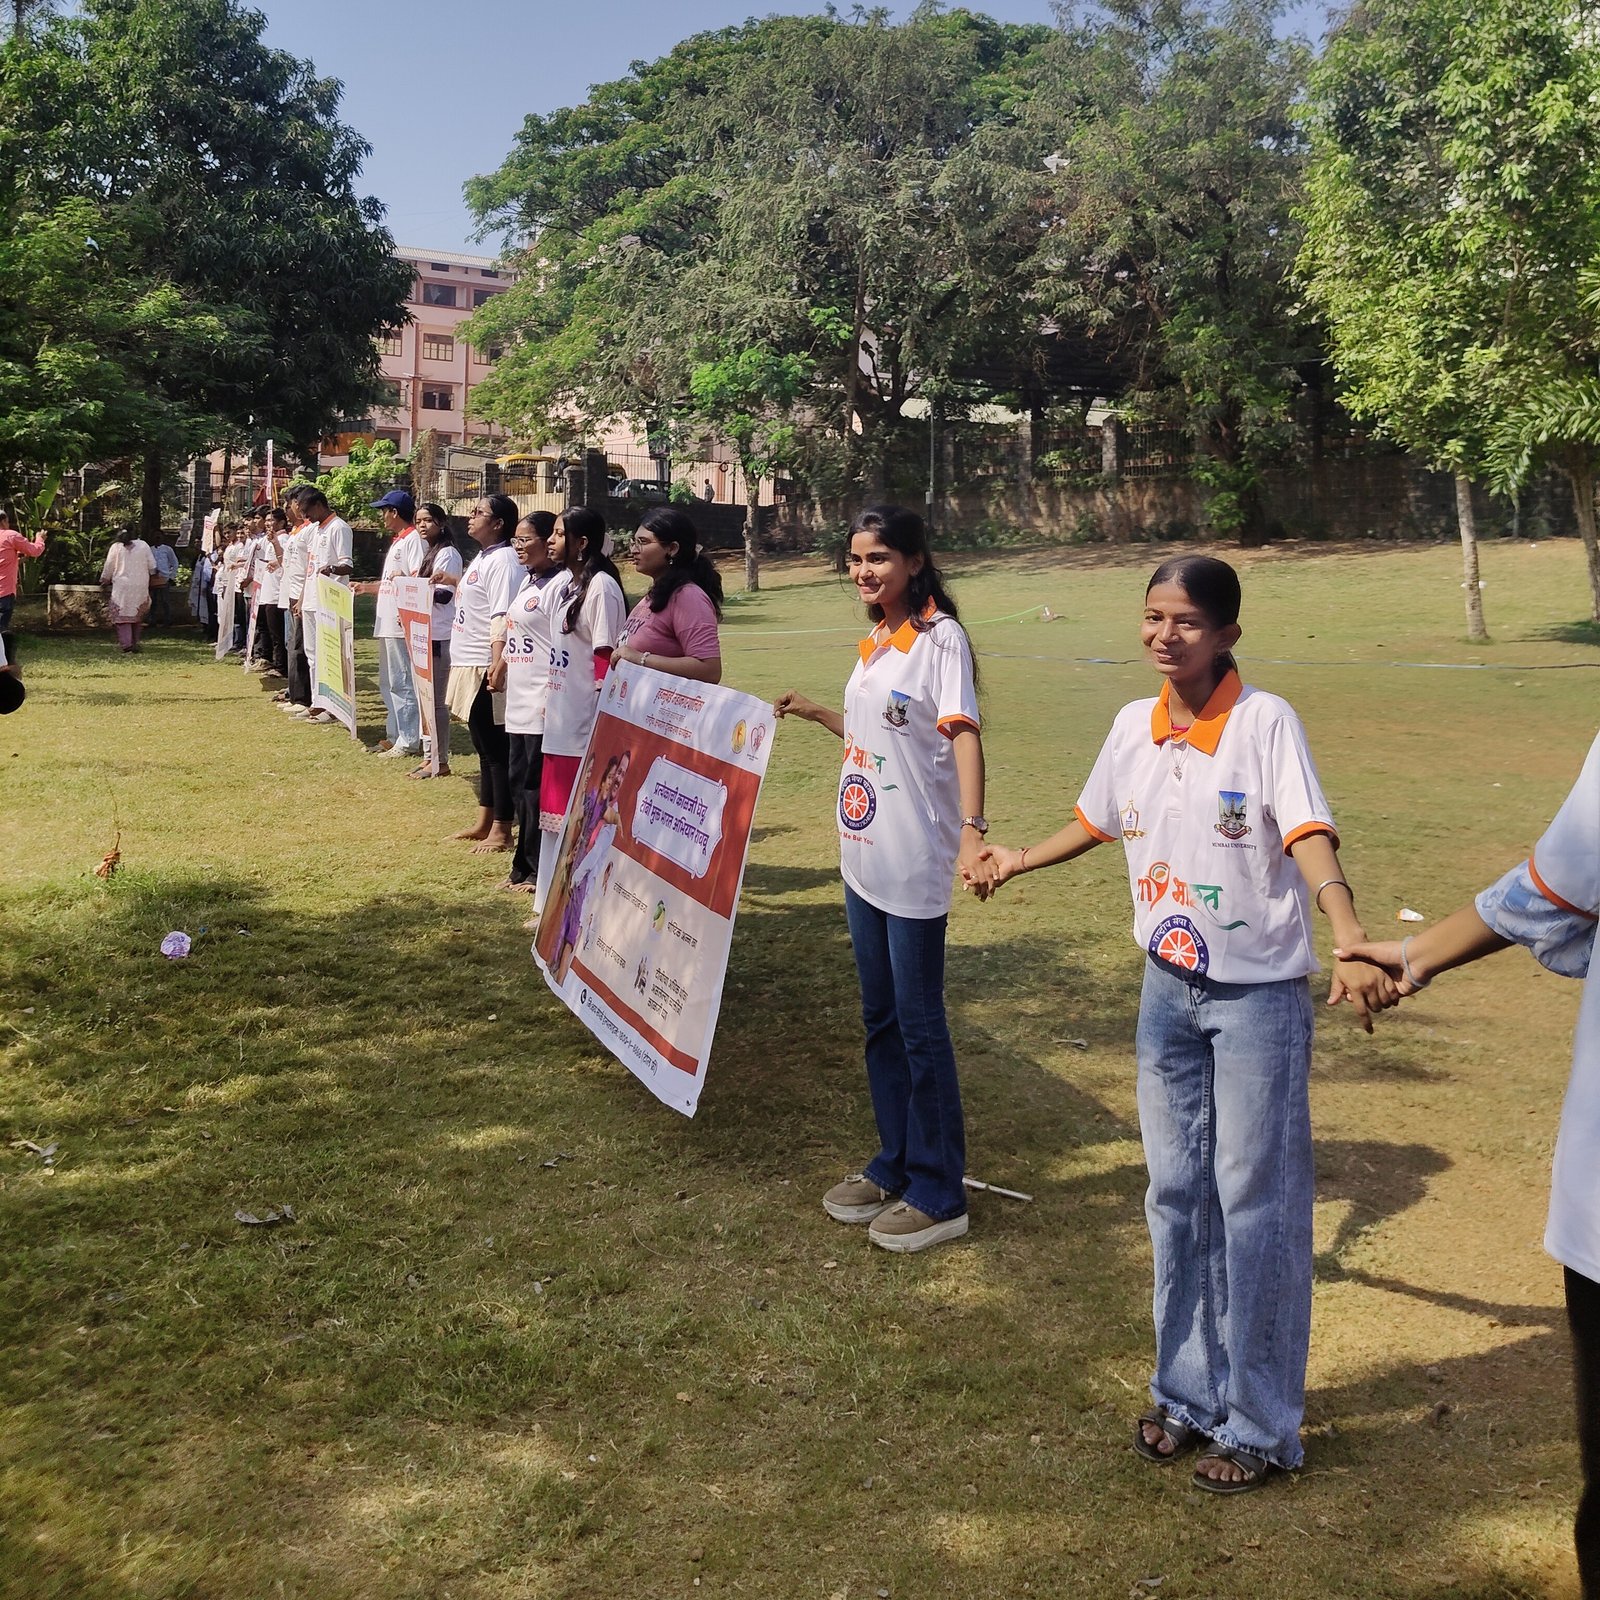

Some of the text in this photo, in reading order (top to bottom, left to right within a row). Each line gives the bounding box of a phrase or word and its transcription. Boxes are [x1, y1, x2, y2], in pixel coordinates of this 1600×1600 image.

[676, 794, 698, 815] काळजी
[661, 810, 674, 829] भारत
[843, 832, 851, 840] Me
[863, 838, 874, 846] You
[1171, 915, 1188, 927] सेवा
